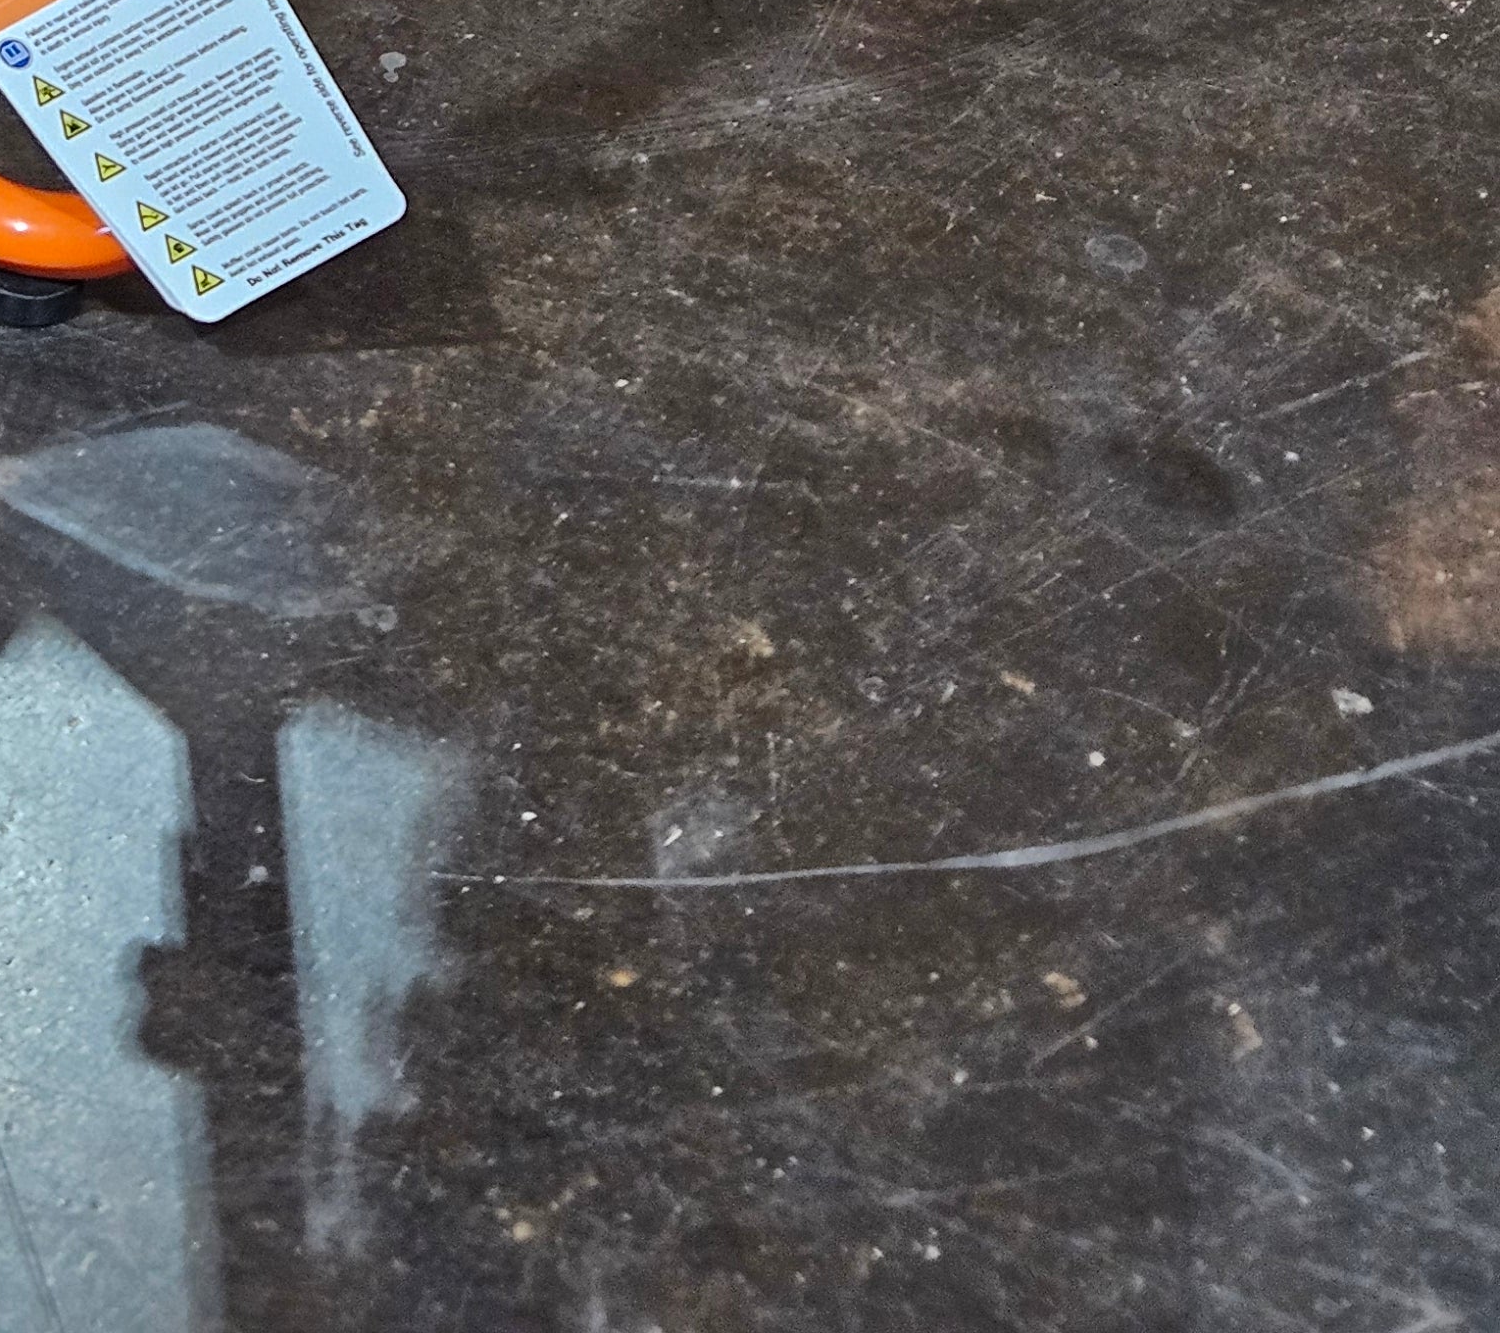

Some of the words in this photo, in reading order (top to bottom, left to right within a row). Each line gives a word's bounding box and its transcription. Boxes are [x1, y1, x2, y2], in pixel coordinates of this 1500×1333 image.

[272, 9, 310, 62] operating
[300, 59, 317, 77] for
[310, 75, 331, 100] side
[325, 98, 354, 138] reverse
[346, 136, 366, 159] See
[246, 273, 262, 287] Do
[262, 262, 282, 278] Not
[281, 240, 323, 268] Remove
[321, 227, 346, 246] This
[343, 215, 368, 234] Tag
